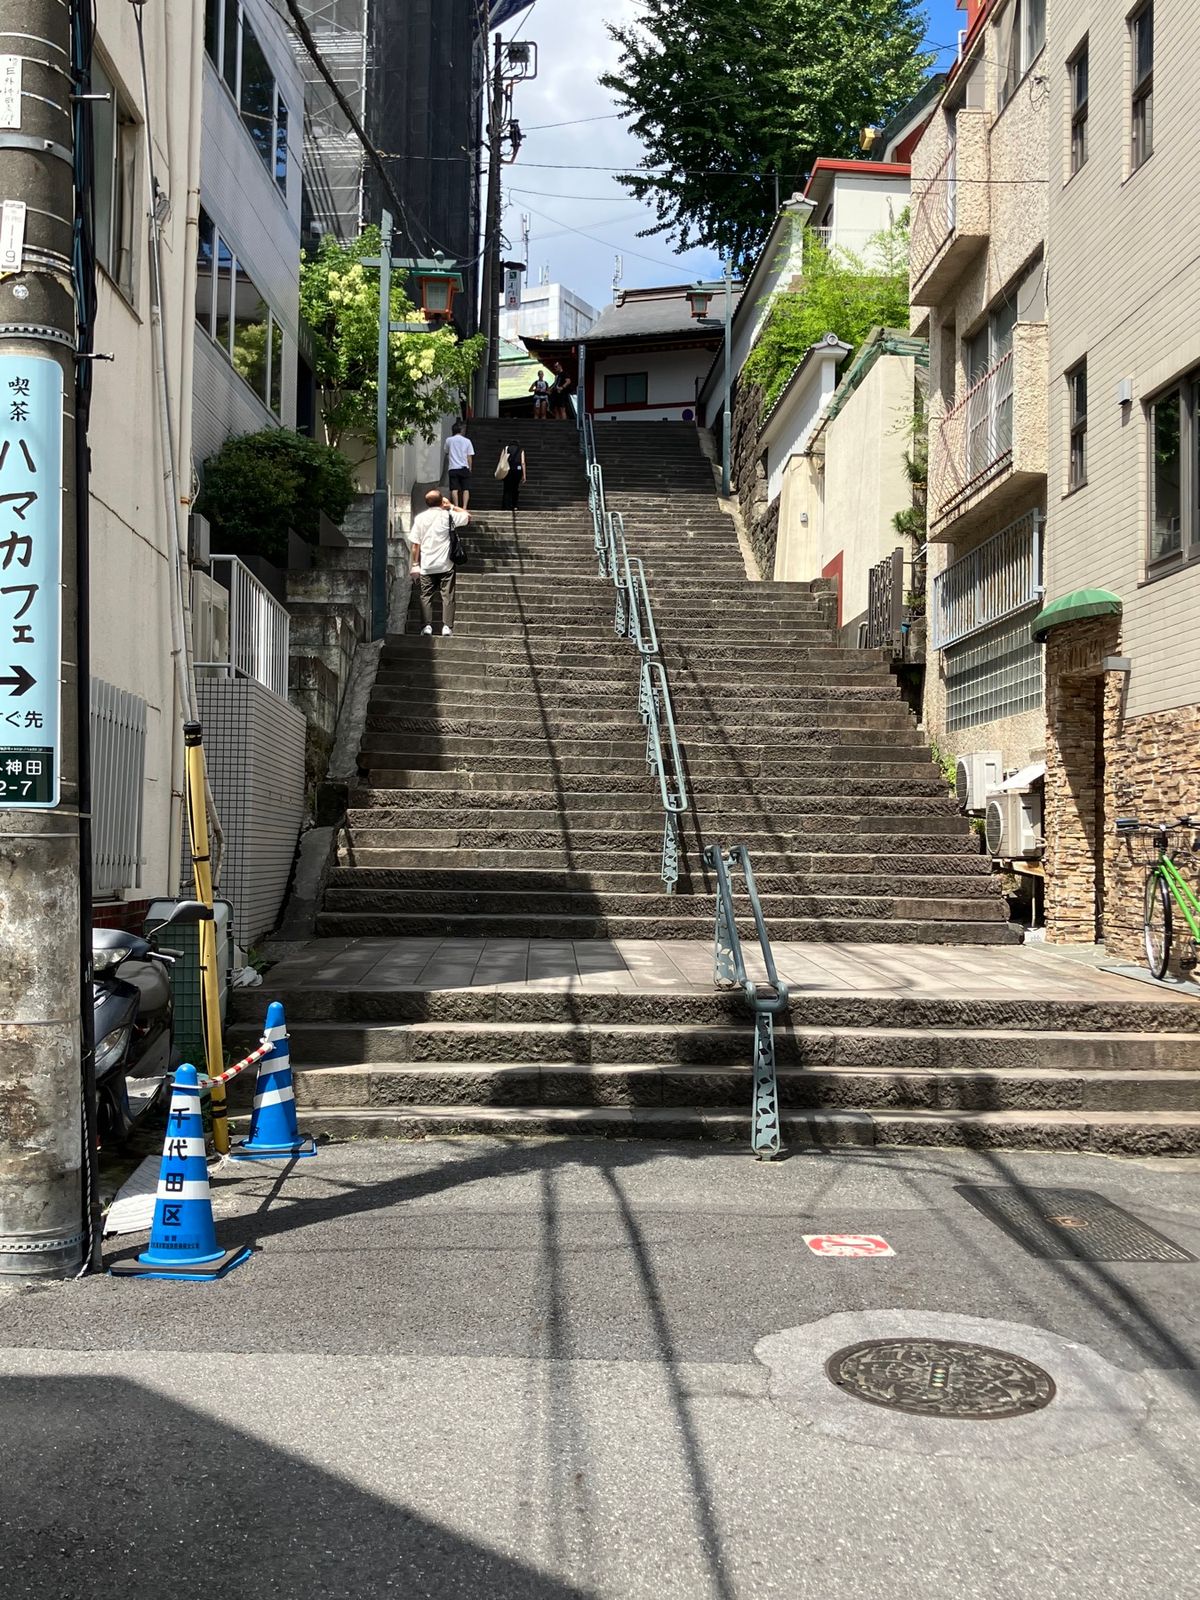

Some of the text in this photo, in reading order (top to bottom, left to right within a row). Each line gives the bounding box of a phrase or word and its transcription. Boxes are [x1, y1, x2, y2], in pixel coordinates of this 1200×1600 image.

[8, 376, 30, 422] 喫茶
[0, 439, 39, 643] ハマカフェ
[0, 710, 43, 728] ぐ先
[0, 759, 42, 776] 神田
[162, 1107, 191, 1227] 千代田区
